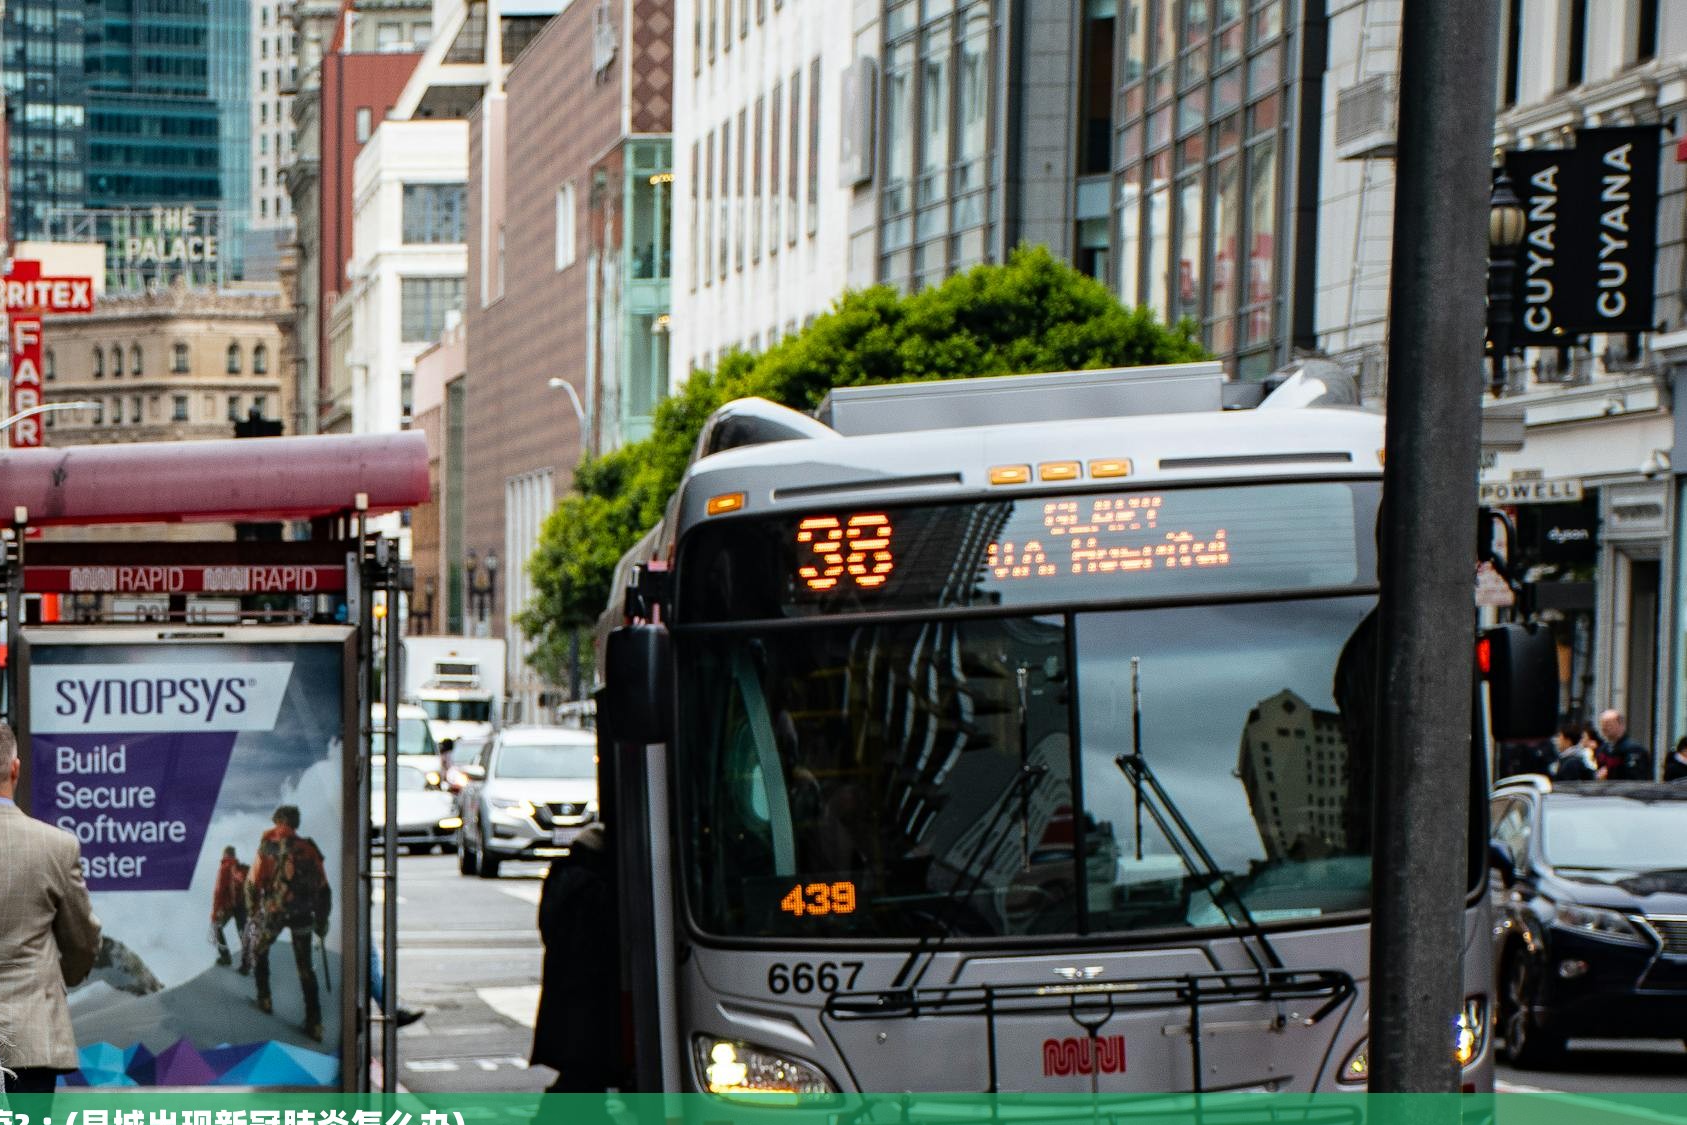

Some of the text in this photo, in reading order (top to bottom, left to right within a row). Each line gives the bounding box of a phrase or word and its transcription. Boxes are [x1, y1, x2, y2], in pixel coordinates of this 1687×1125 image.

[153, 206, 195, 231] THE
[1597, 143, 1632, 317] CUYANA
[127, 236, 217, 262] PALACE
[1524, 165, 1558, 332] CUYANA
[1481, 481, 1576, 499] POWELL
[797, 514, 894, 589] 38
[119, 566, 184, 591] RAPID
[251, 566, 317, 591] RAPID
[56, 678, 247, 723] SYNOPSYS
[56, 744, 126, 774] Build
[56, 781, 156, 809] Secure
[80, 852, 147, 878] aster
[781, 881, 856, 916] 439
[768, 961, 864, 994] 6667
